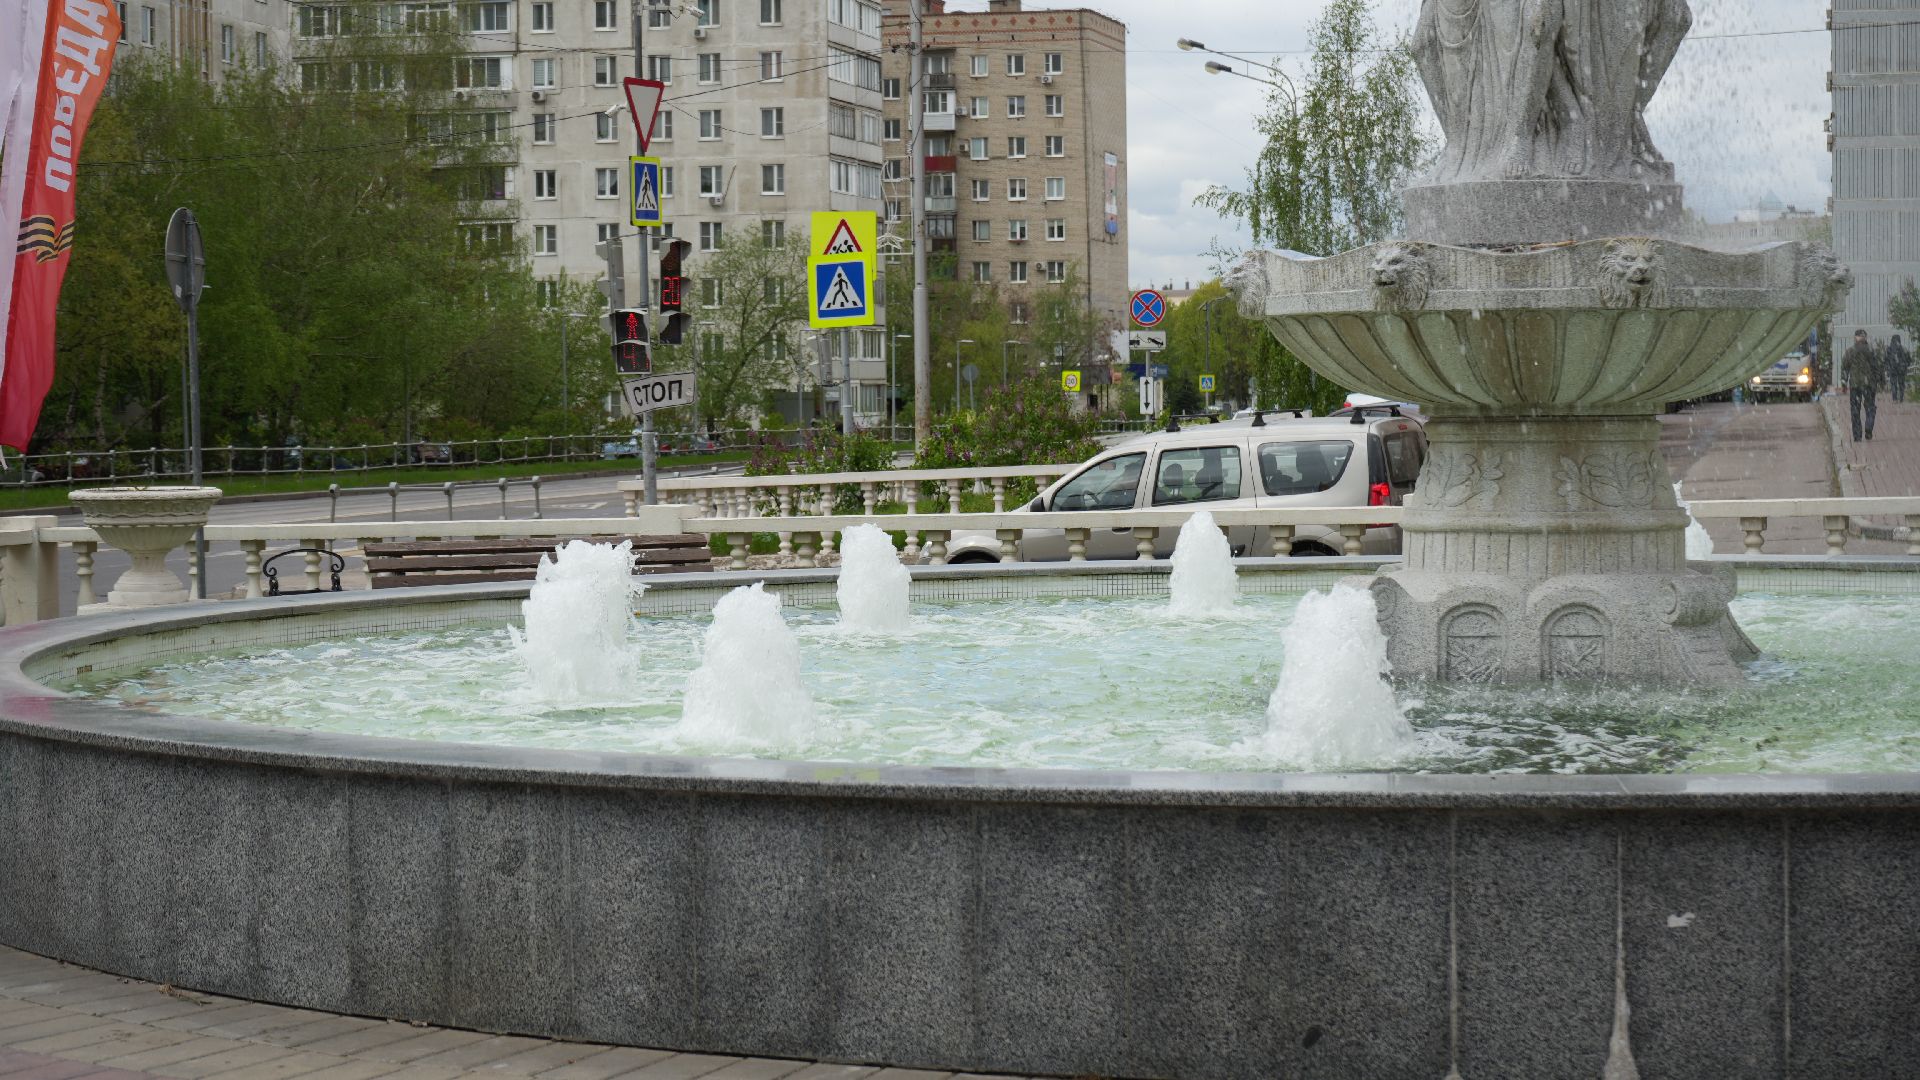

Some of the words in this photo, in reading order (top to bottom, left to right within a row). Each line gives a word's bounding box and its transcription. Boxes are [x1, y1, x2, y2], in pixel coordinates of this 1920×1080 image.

[45, 0, 109, 193] ПОБЕДА
[662, 276, 681, 305] 20
[633, 379, 683, 406] СТОП
